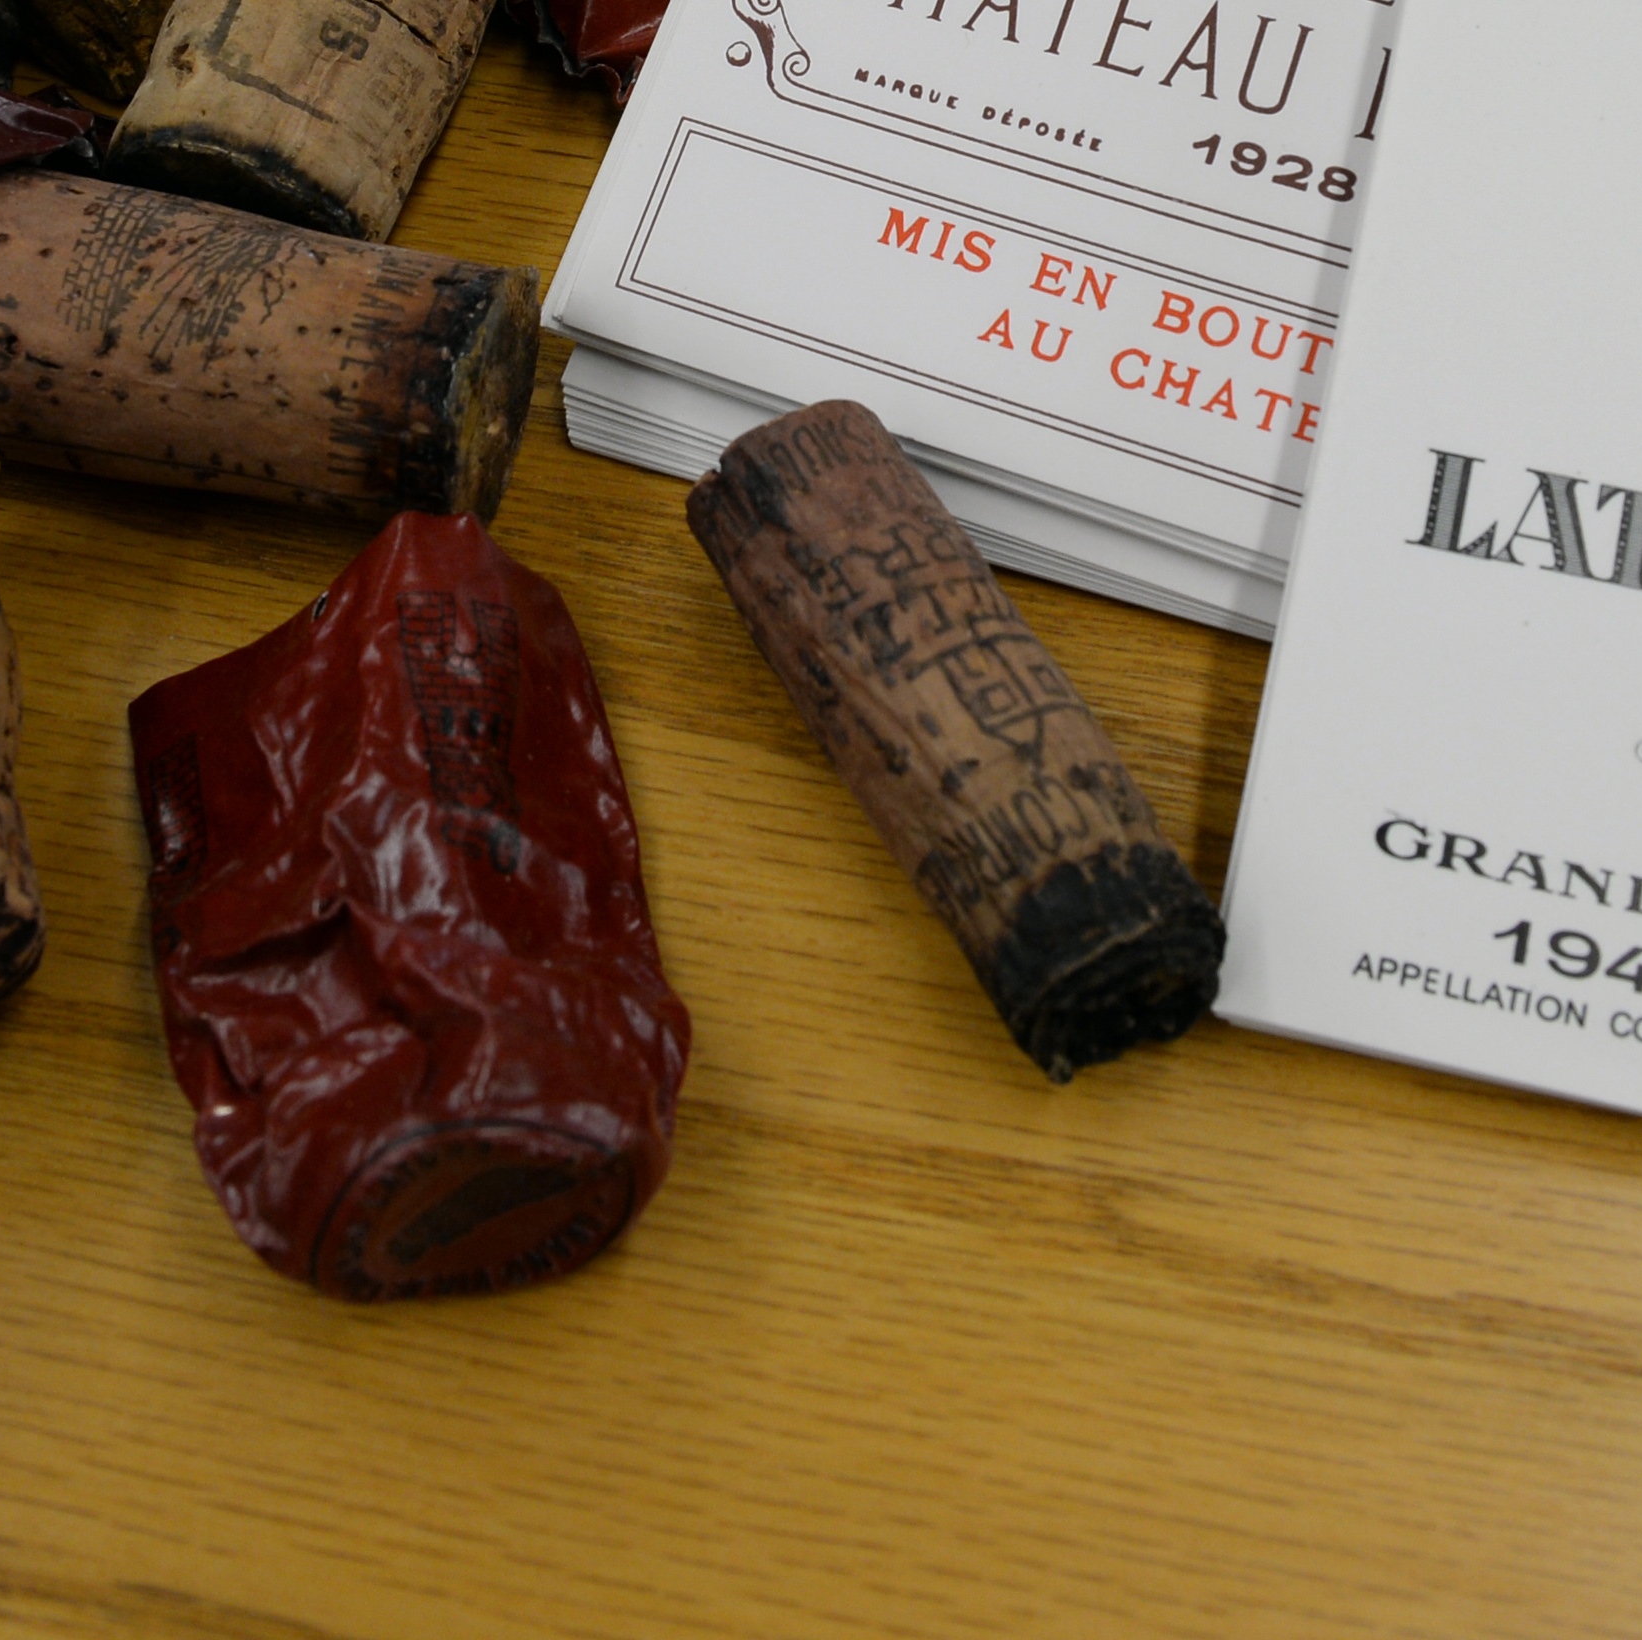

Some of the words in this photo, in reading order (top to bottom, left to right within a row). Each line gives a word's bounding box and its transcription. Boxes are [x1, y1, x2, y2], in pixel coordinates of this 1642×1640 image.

[854, 66, 960, 112] MARQUE
[980, 103, 1105, 153] DÉPOSÉE
[1191, 133, 1359, 205] 1928
[877, 207, 997, 275] MIS
[1028, 252, 1120, 312] EN
[977, 308, 1074, 365] AU
[1351, 951, 1590, 1031] APPELLATION
